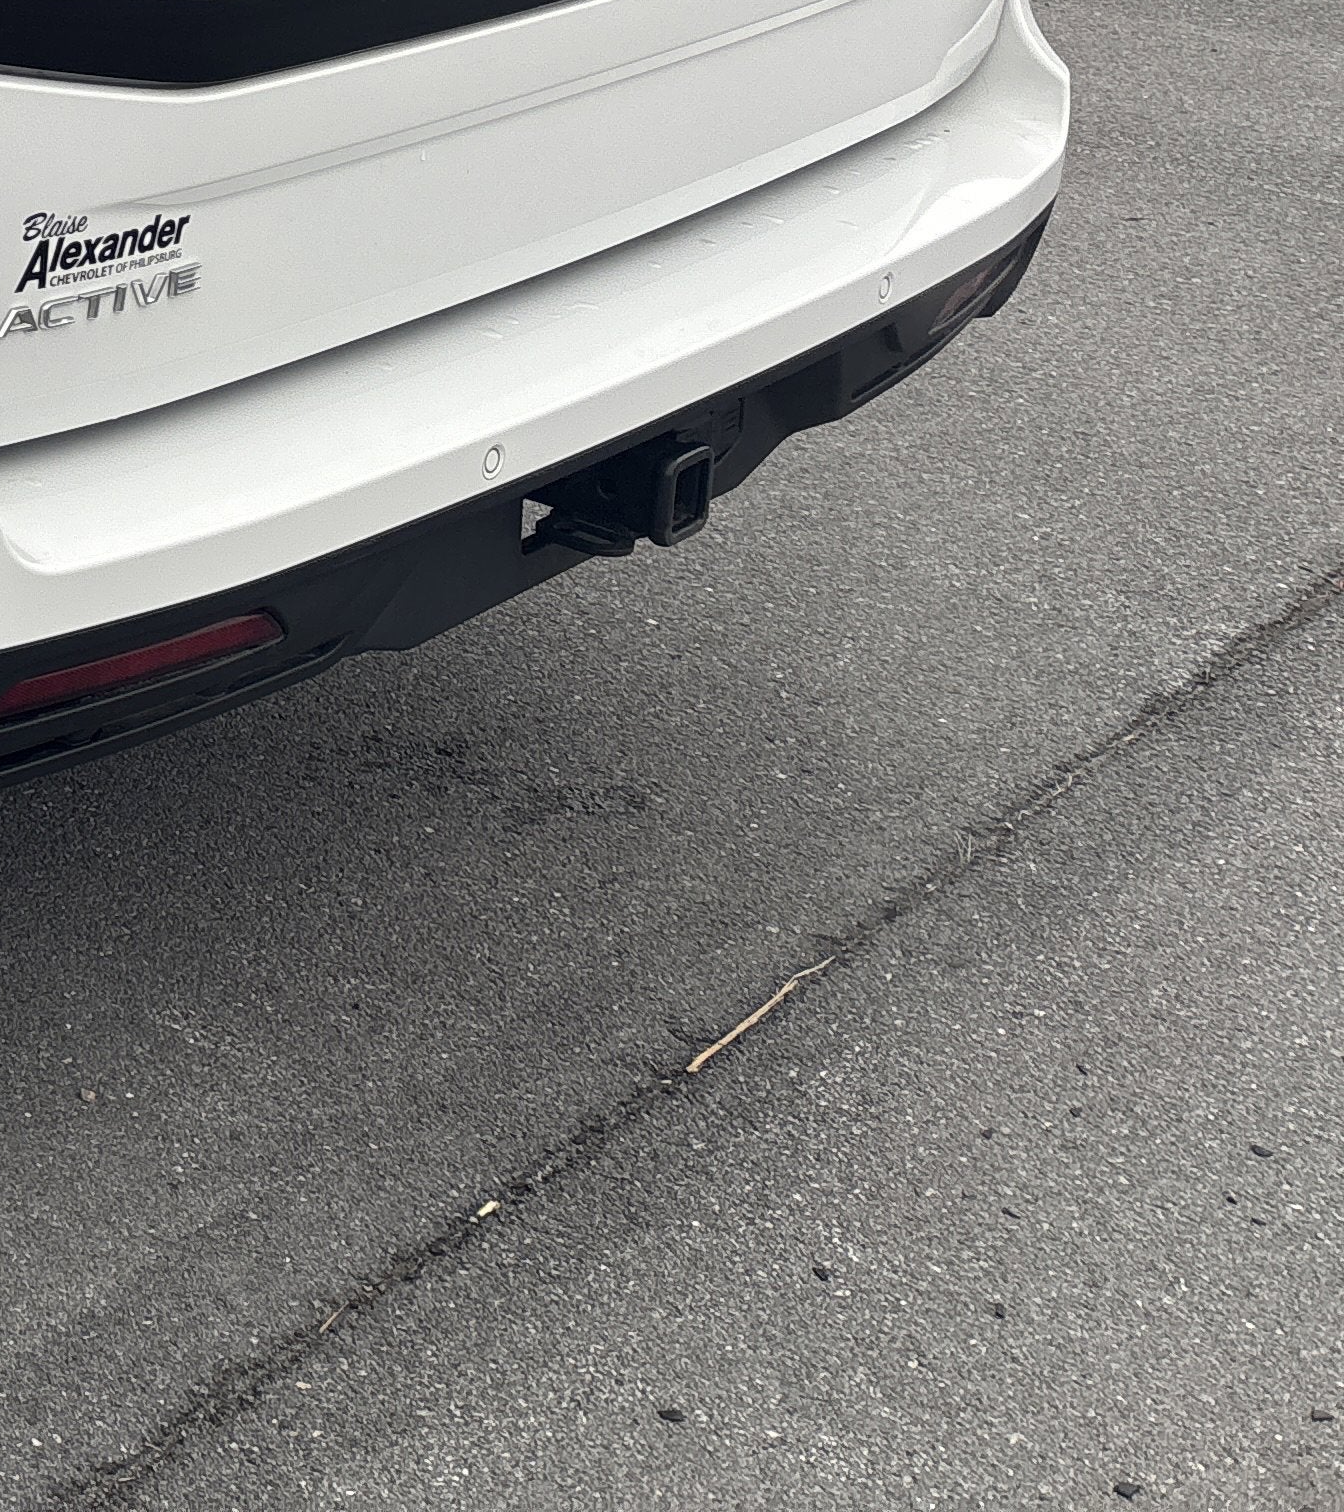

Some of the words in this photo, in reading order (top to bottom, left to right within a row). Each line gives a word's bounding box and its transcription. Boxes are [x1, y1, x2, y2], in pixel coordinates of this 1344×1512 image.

[22, 212, 88, 241] Blaise
[14, 214, 191, 293] Alexander
[49, 264, 114, 287] CHEVROLET
[116, 262, 129, 274] OF
[129, 248, 182, 271] PHILIPSBURG
